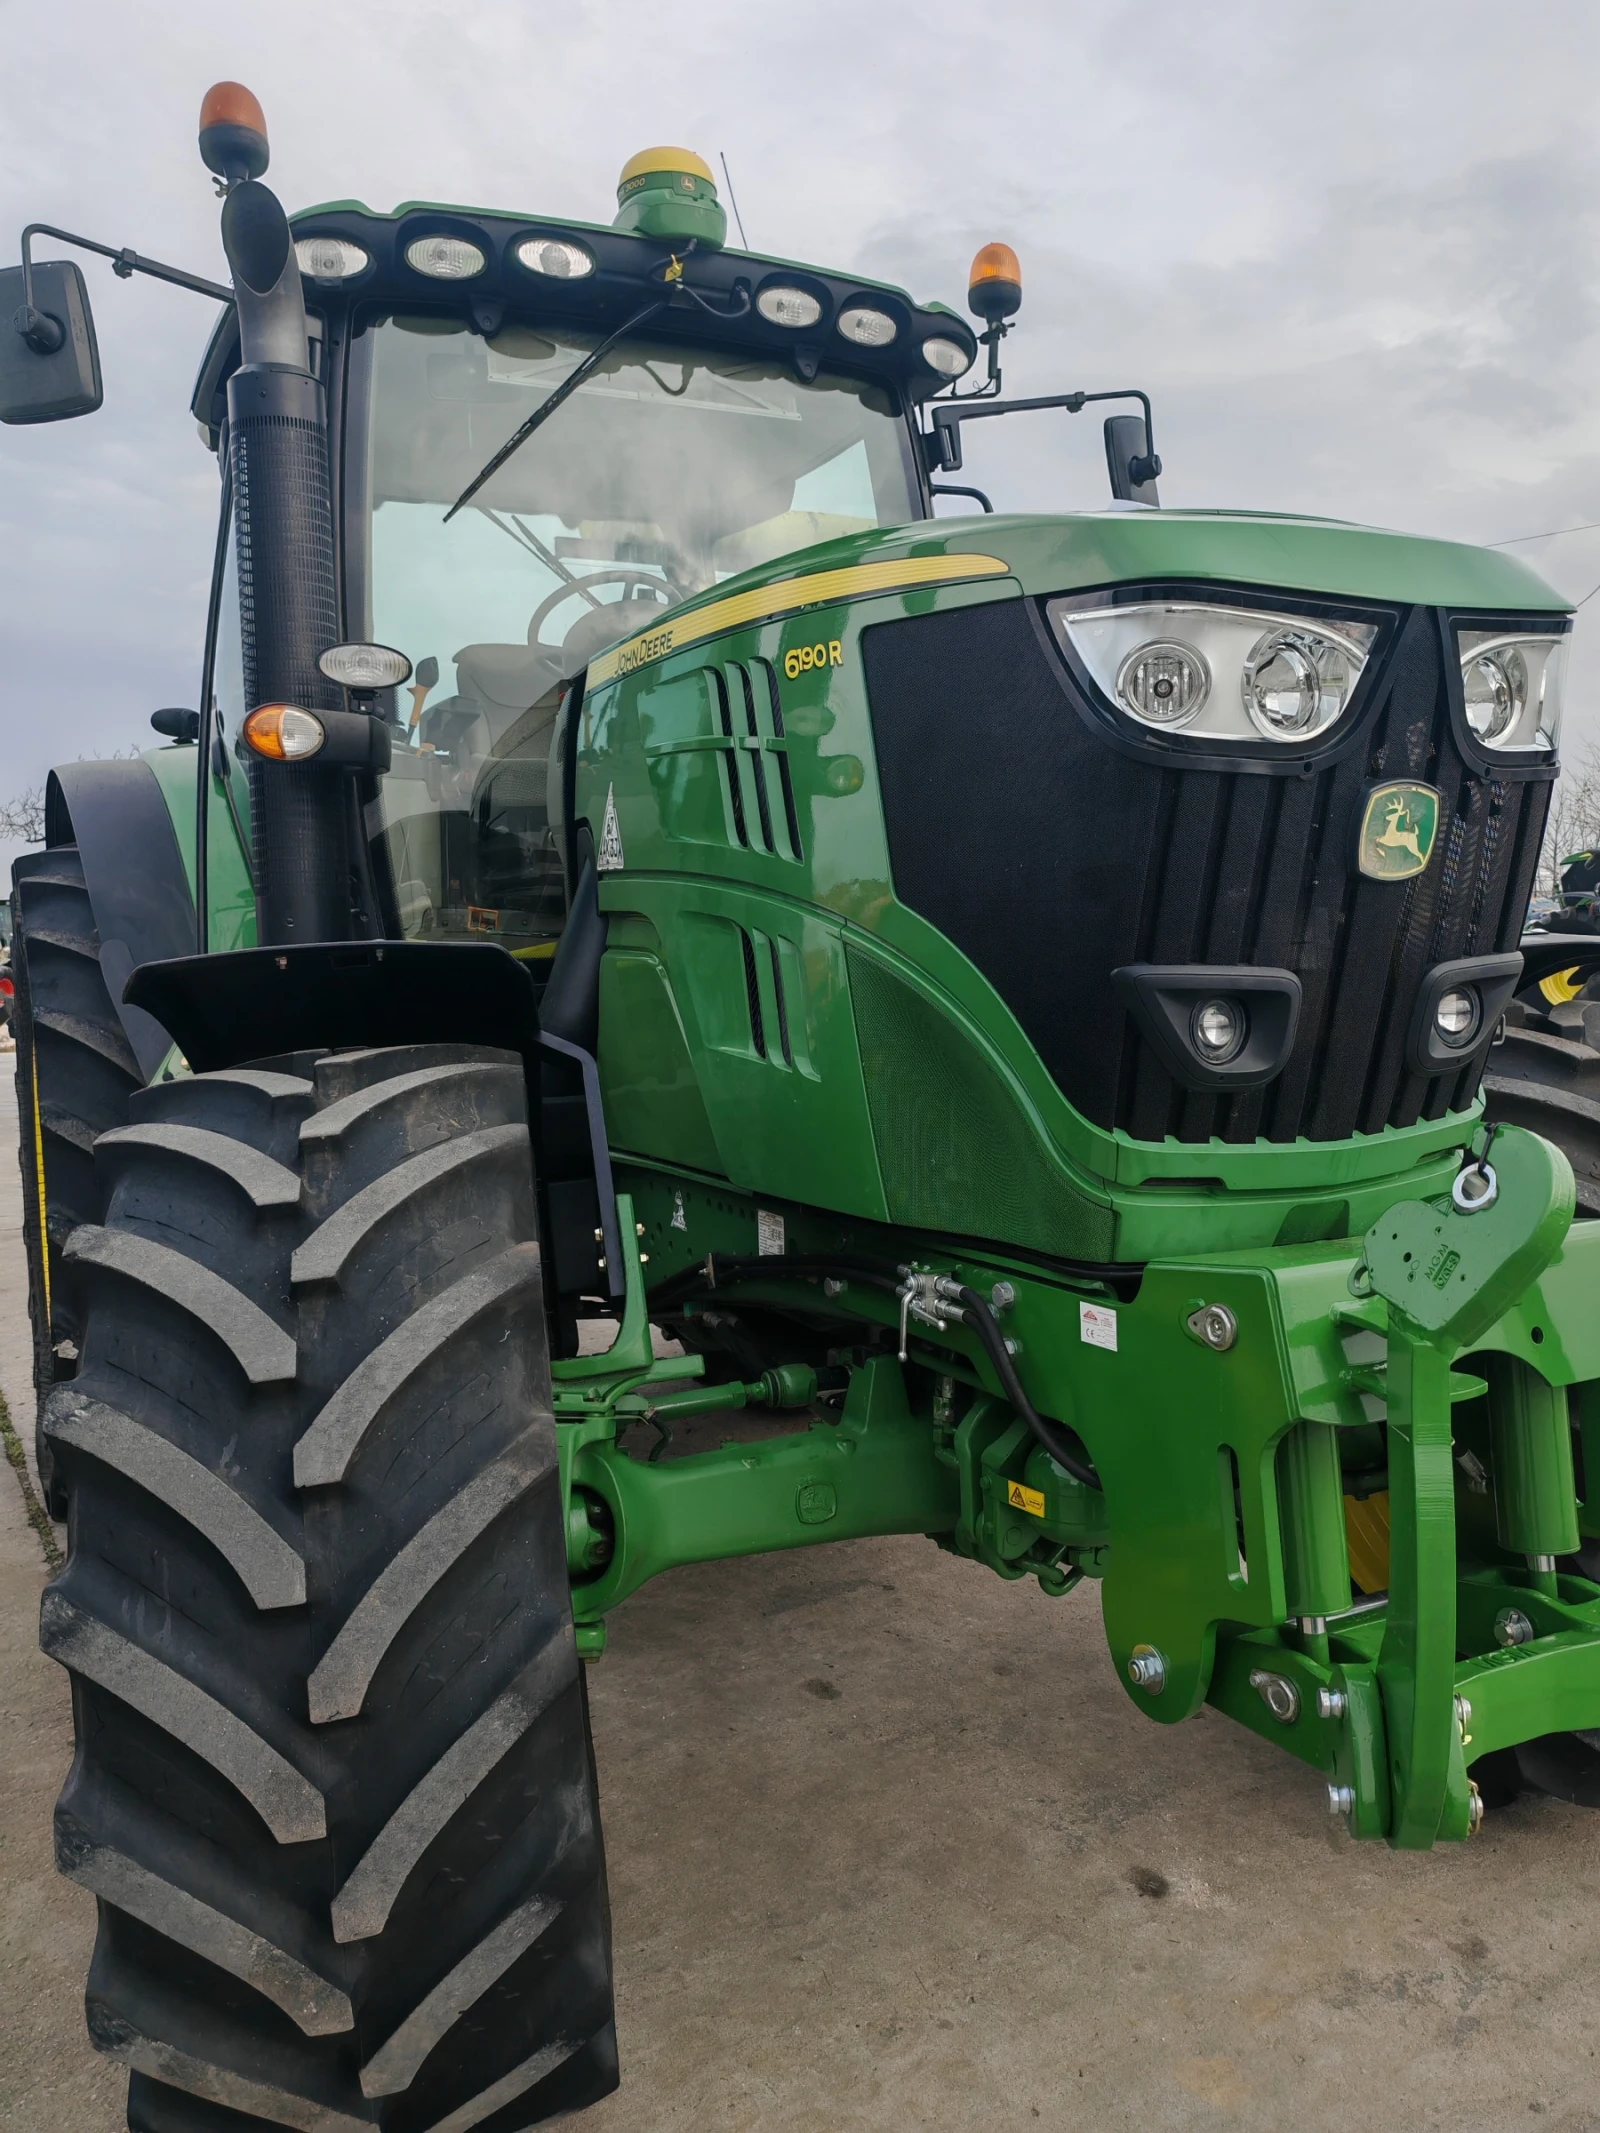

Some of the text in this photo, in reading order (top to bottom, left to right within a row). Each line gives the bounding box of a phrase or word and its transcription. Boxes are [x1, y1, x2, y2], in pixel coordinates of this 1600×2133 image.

[614, 630, 673, 675] JOHN DEERE
[785, 640, 843, 679] 6190 R
[1424, 1243, 1449, 1280] MGM
